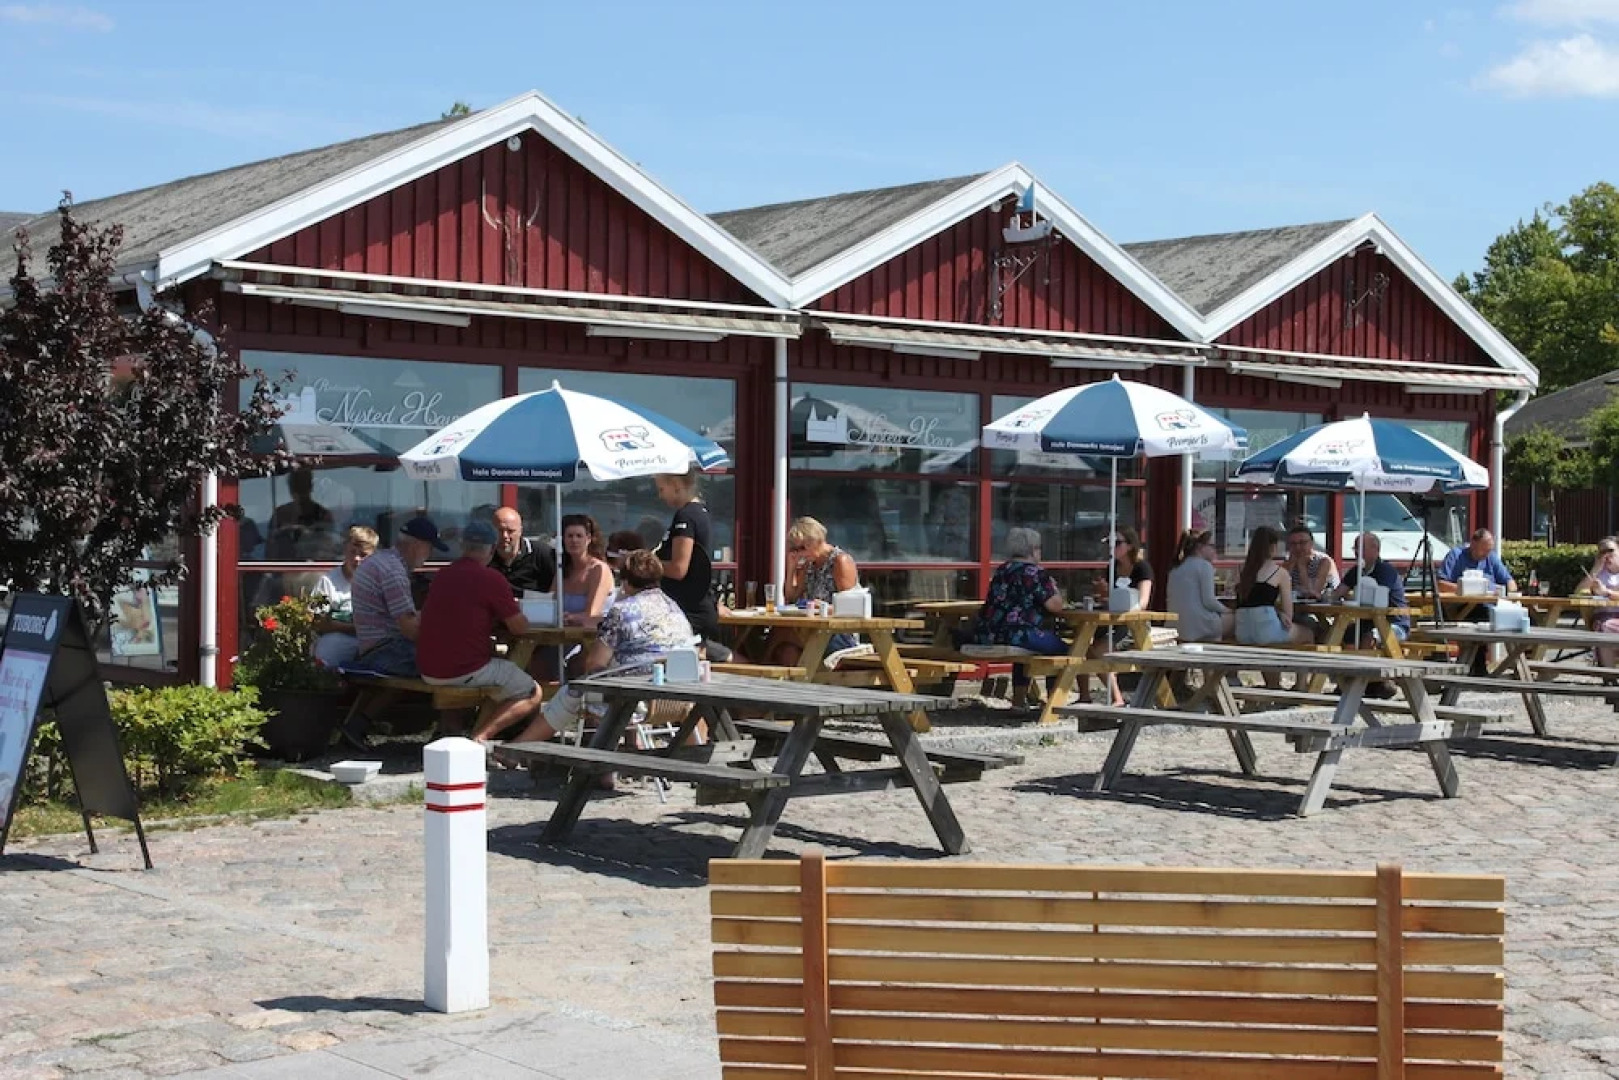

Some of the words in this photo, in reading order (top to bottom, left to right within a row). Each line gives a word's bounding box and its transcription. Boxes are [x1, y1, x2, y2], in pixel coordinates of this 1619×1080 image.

[316, 388, 395, 432] Nysted
[907, 414, 954, 447] Havn
[12, 612, 47, 636] TUBORG
